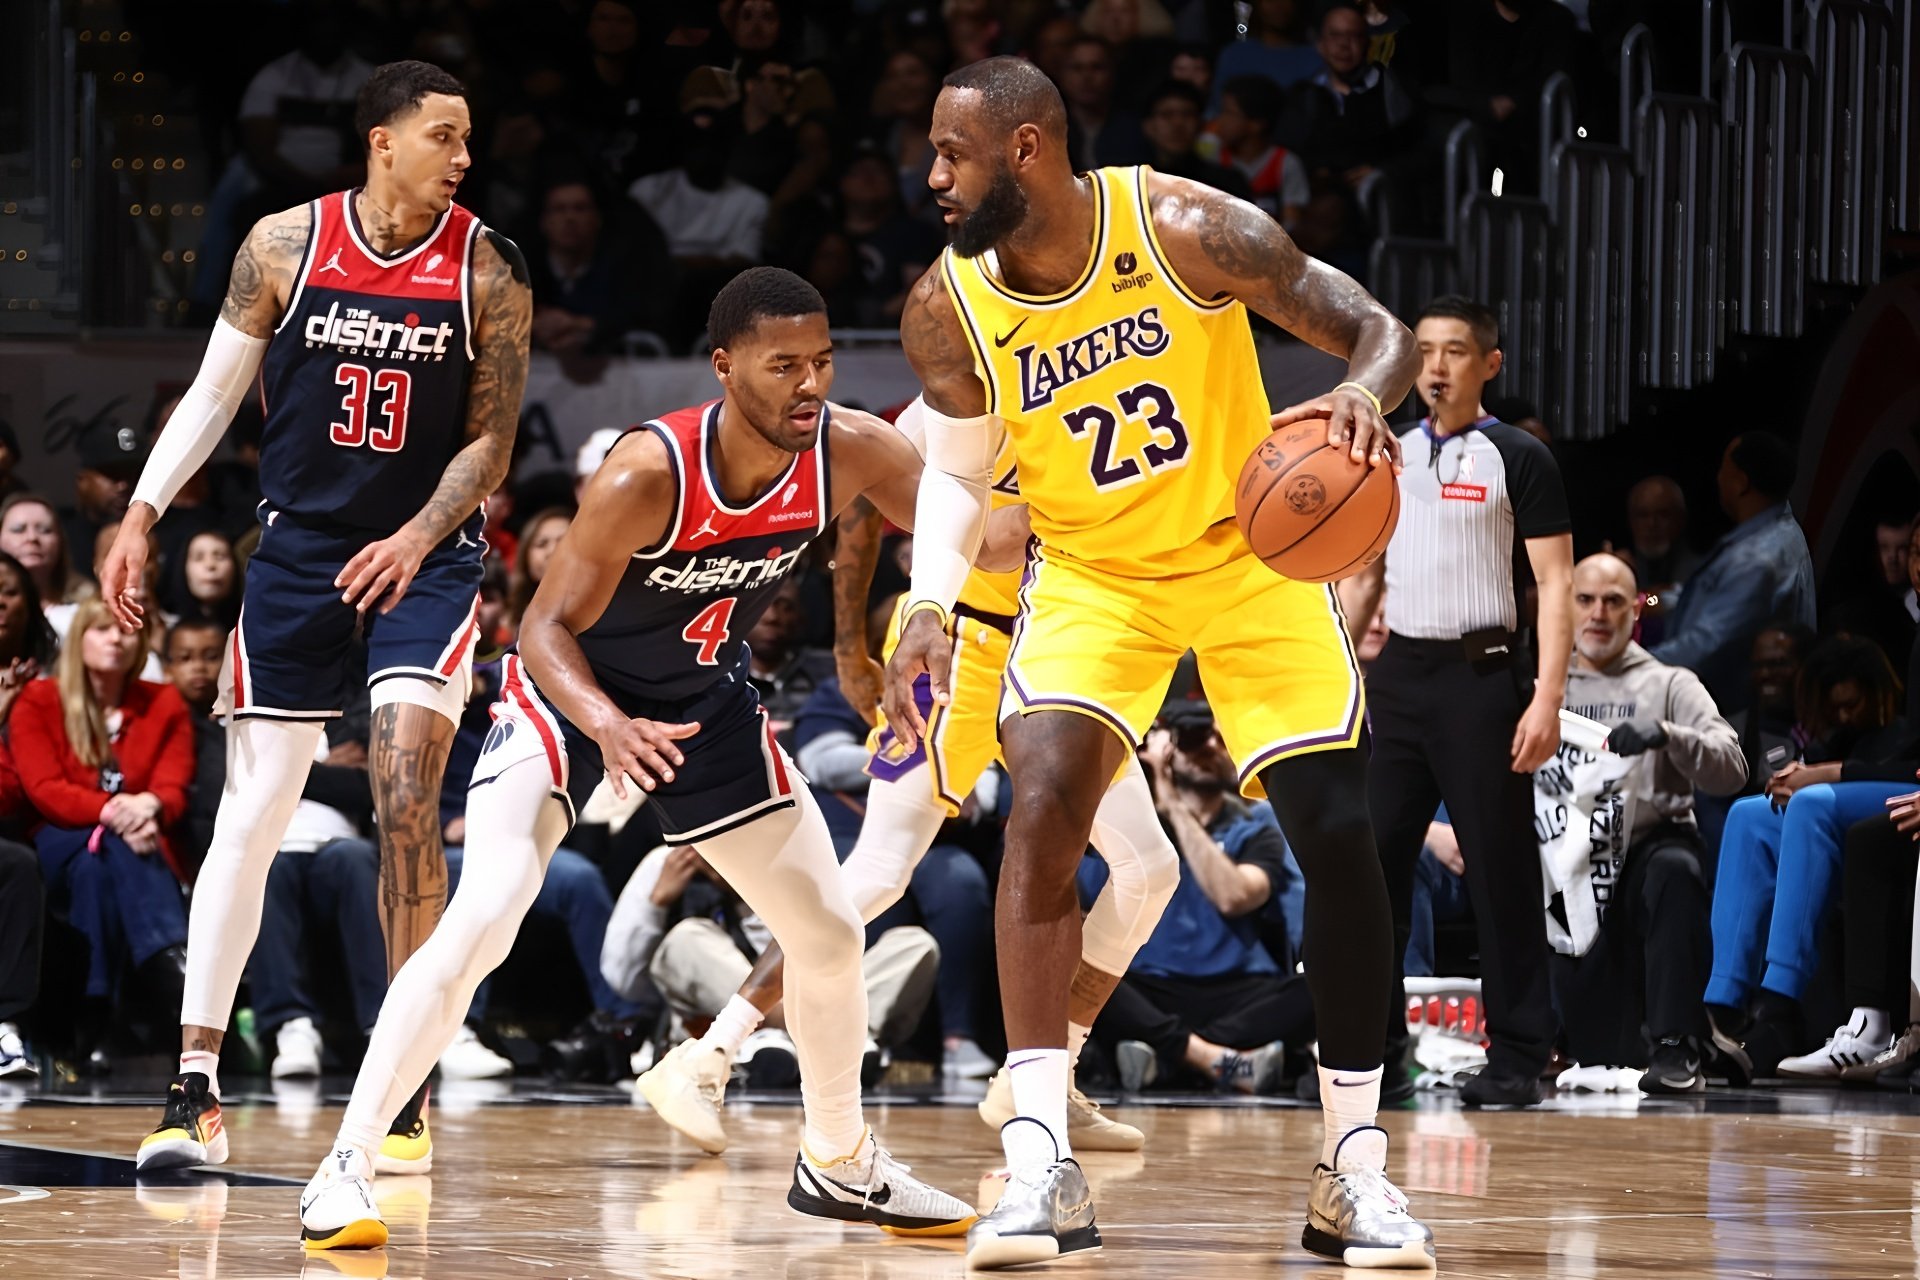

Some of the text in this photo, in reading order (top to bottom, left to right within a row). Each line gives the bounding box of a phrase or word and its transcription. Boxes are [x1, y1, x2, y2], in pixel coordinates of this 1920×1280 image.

[346, 308, 371, 319] THE
[1111, 272, 1154, 293] bibigo
[305, 301, 454, 354] district
[1013, 306, 1172, 414] LAKERS
[329, 363, 412, 452] 33
[1060, 380, 1192, 494] 23
[682, 597, 738, 666] 4
